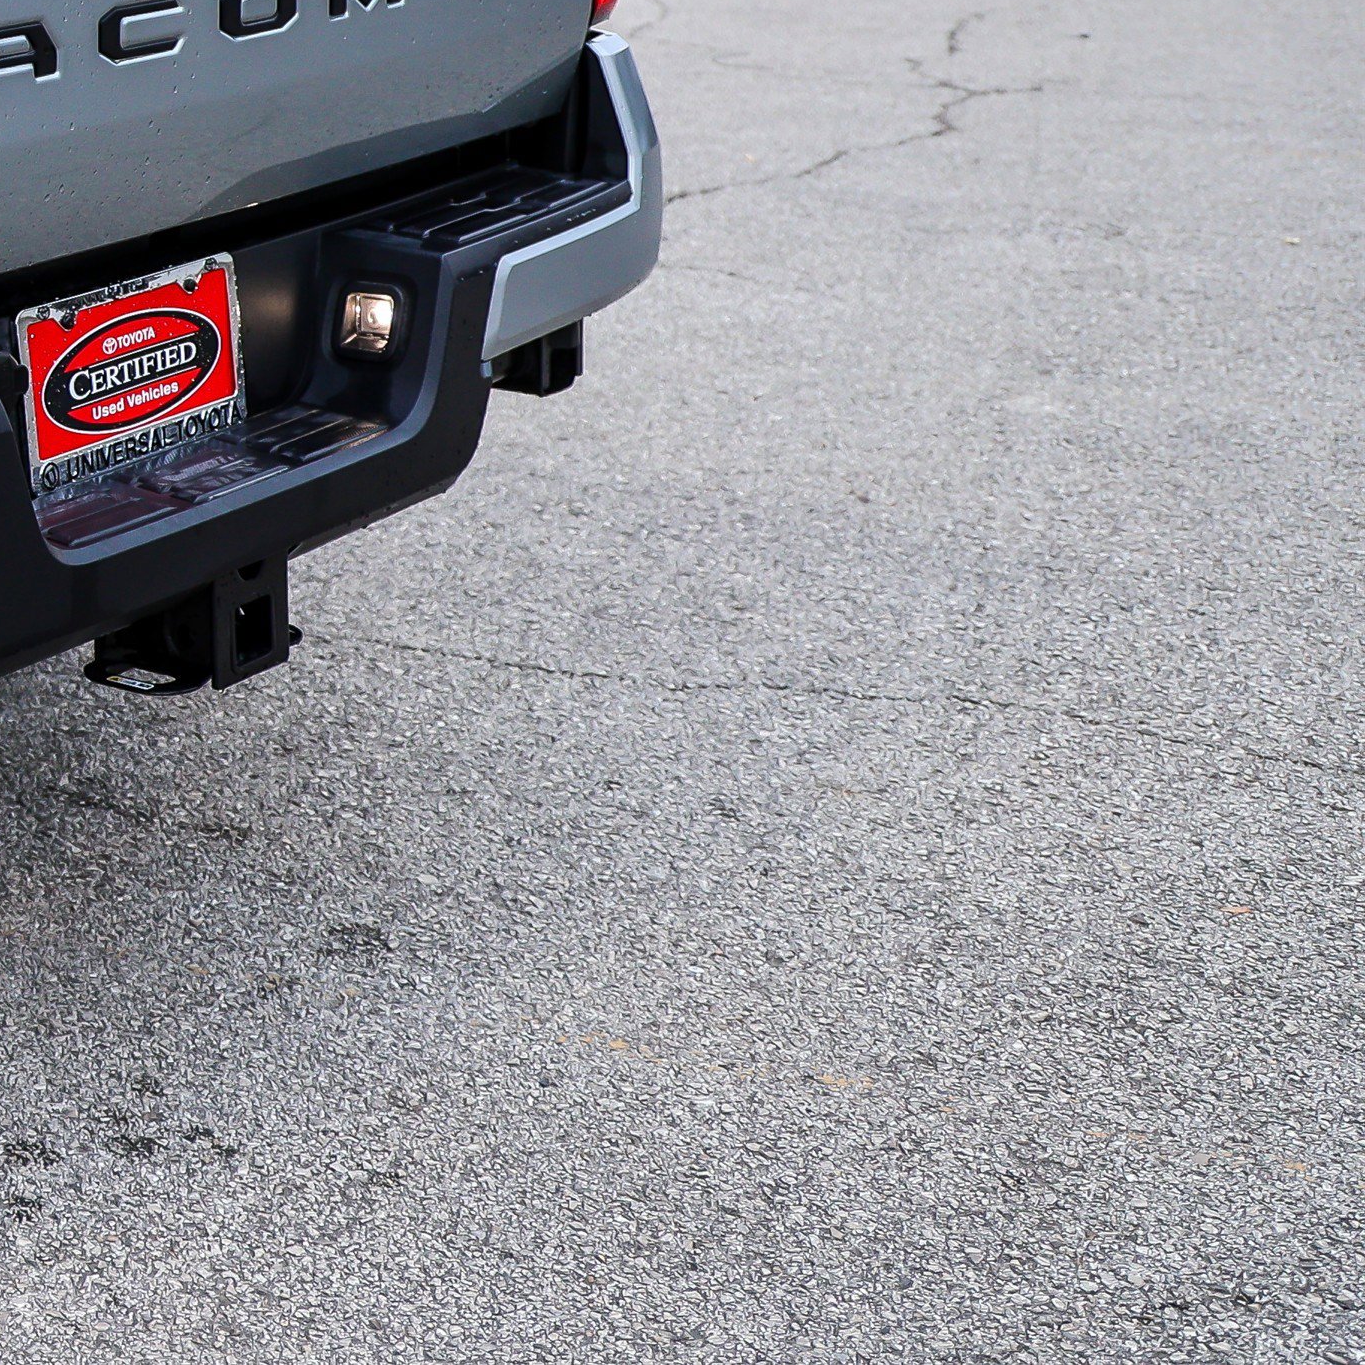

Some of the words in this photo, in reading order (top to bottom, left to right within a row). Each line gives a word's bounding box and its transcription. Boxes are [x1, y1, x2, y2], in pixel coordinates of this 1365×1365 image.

[118, 326, 155, 349] TOYOTA
[69, 342, 197, 400] CERTIFIED
[127, 381, 179, 409] Vehicles
[92, 400, 125, 420] Used
[68, 426, 172, 481] UNIVERSAL
[174, 402, 243, 442] TOYOTA
